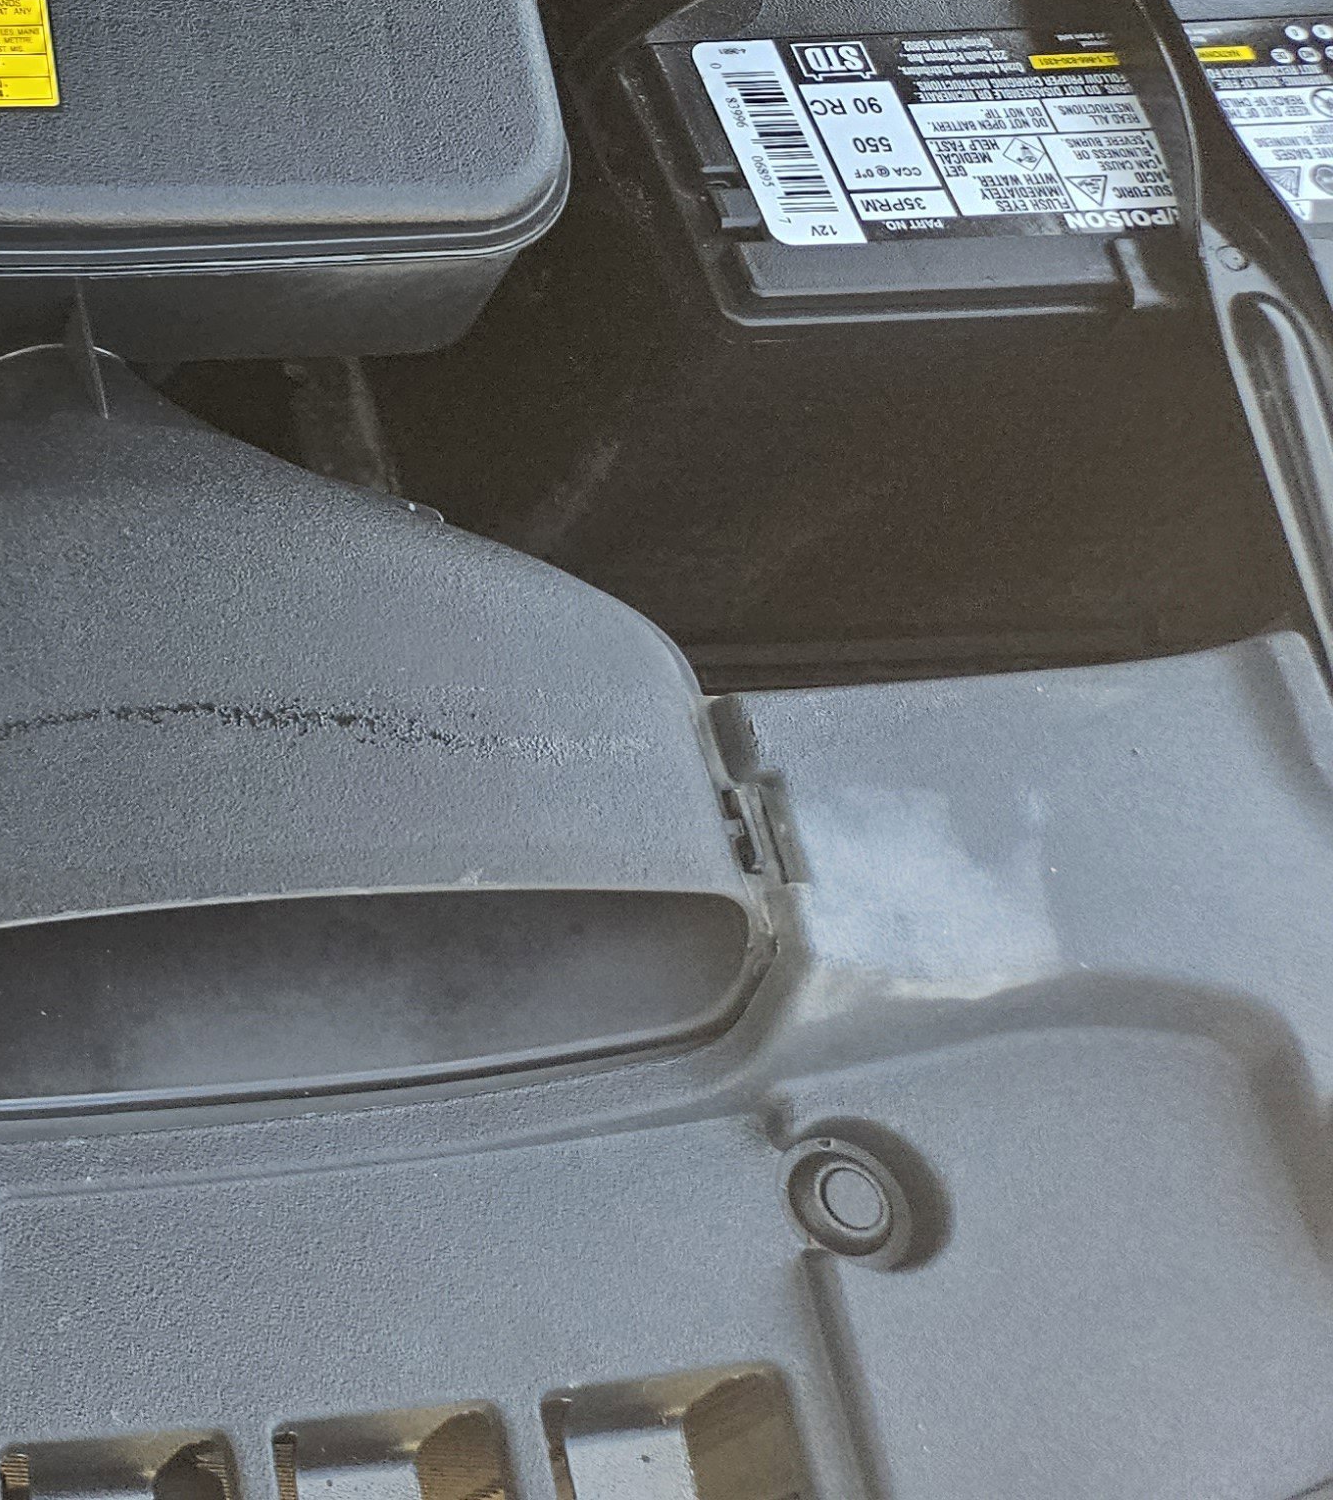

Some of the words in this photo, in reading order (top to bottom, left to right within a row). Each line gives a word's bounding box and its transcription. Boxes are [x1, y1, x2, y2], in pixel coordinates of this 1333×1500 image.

[13, 7, 32, 15] ANY
[804, 45, 865, 72] STD
[990, 76, 1044, 89] CHARGING
[1042, 74, 1085, 86] PROPER
[1084, 73, 1127, 84] FOLLOW
[913, 79, 991, 92] INSTRUCTIONS.
[1064, 84, 1086, 96] NOT
[1085, 84, 1103, 95] DO
[975, 89, 994, 100] OR
[993, 86, 1063, 100] DISASSEMBLE
[853, 96, 883, 115] 90
[1255, 96, 1268, 107] OF
[1272, 95, 1305, 106] REACH
[810, 98, 847, 117] RC
[980, 108, 1002, 119] TIP.
[1001, 107, 1025, 118] NOT
[1026, 106, 1043, 117] DO
[1053, 102, 1135, 116] INSTRUCTIONS.
[1246, 107, 1259, 118] OF
[1261, 106, 1282, 118] OUT
[1007, 118, 1031, 130] NOT
[1032, 117, 1049, 128] DO
[1089, 114, 1110, 126] ALL
[1113, 113, 1141, 124] READ
[927, 120, 978, 132] BATTERY.
[977, 119, 1007, 131] OPEN
[724, 97, 750, 129] 83996
[751, 154, 775, 188] 06895
[852, 136, 893, 154] 550
[930, 139, 966, 152] FAST.
[969, 138, 1000, 151] HELP
[1061, 136, 1103, 149] BURNS.
[1104, 134, 1145, 146] SEVERE
[935, 151, 993, 165] MEDICAL
[1073, 149, 1091, 161] OR
[1092, 147, 1151, 159] BLINDNESS
[1273, 147, 1313, 161] GASES
[1097, 160, 1134, 172] CAUSE
[1136, 159, 1158, 171] CAN
[892, 166, 922, 177] CCA
[943, 165, 968, 178] GET
[1134, 171, 1165, 184] ACID
[973, 173, 1023, 188] WATER.
[1022, 172, 1059, 186] WITH
[979, 185, 1065, 200] IMMEDIATELY
[1111, 184, 1173, 199] SULFURIC
[860, 197, 927, 213] 35PRM
[995, 198, 1029, 212] EYES
[1030, 197, 1071, 211] FLUSH
[881, 219, 907, 231] NO.
[906, 218, 946, 230] PART
[811, 225, 838, 237] 12V
